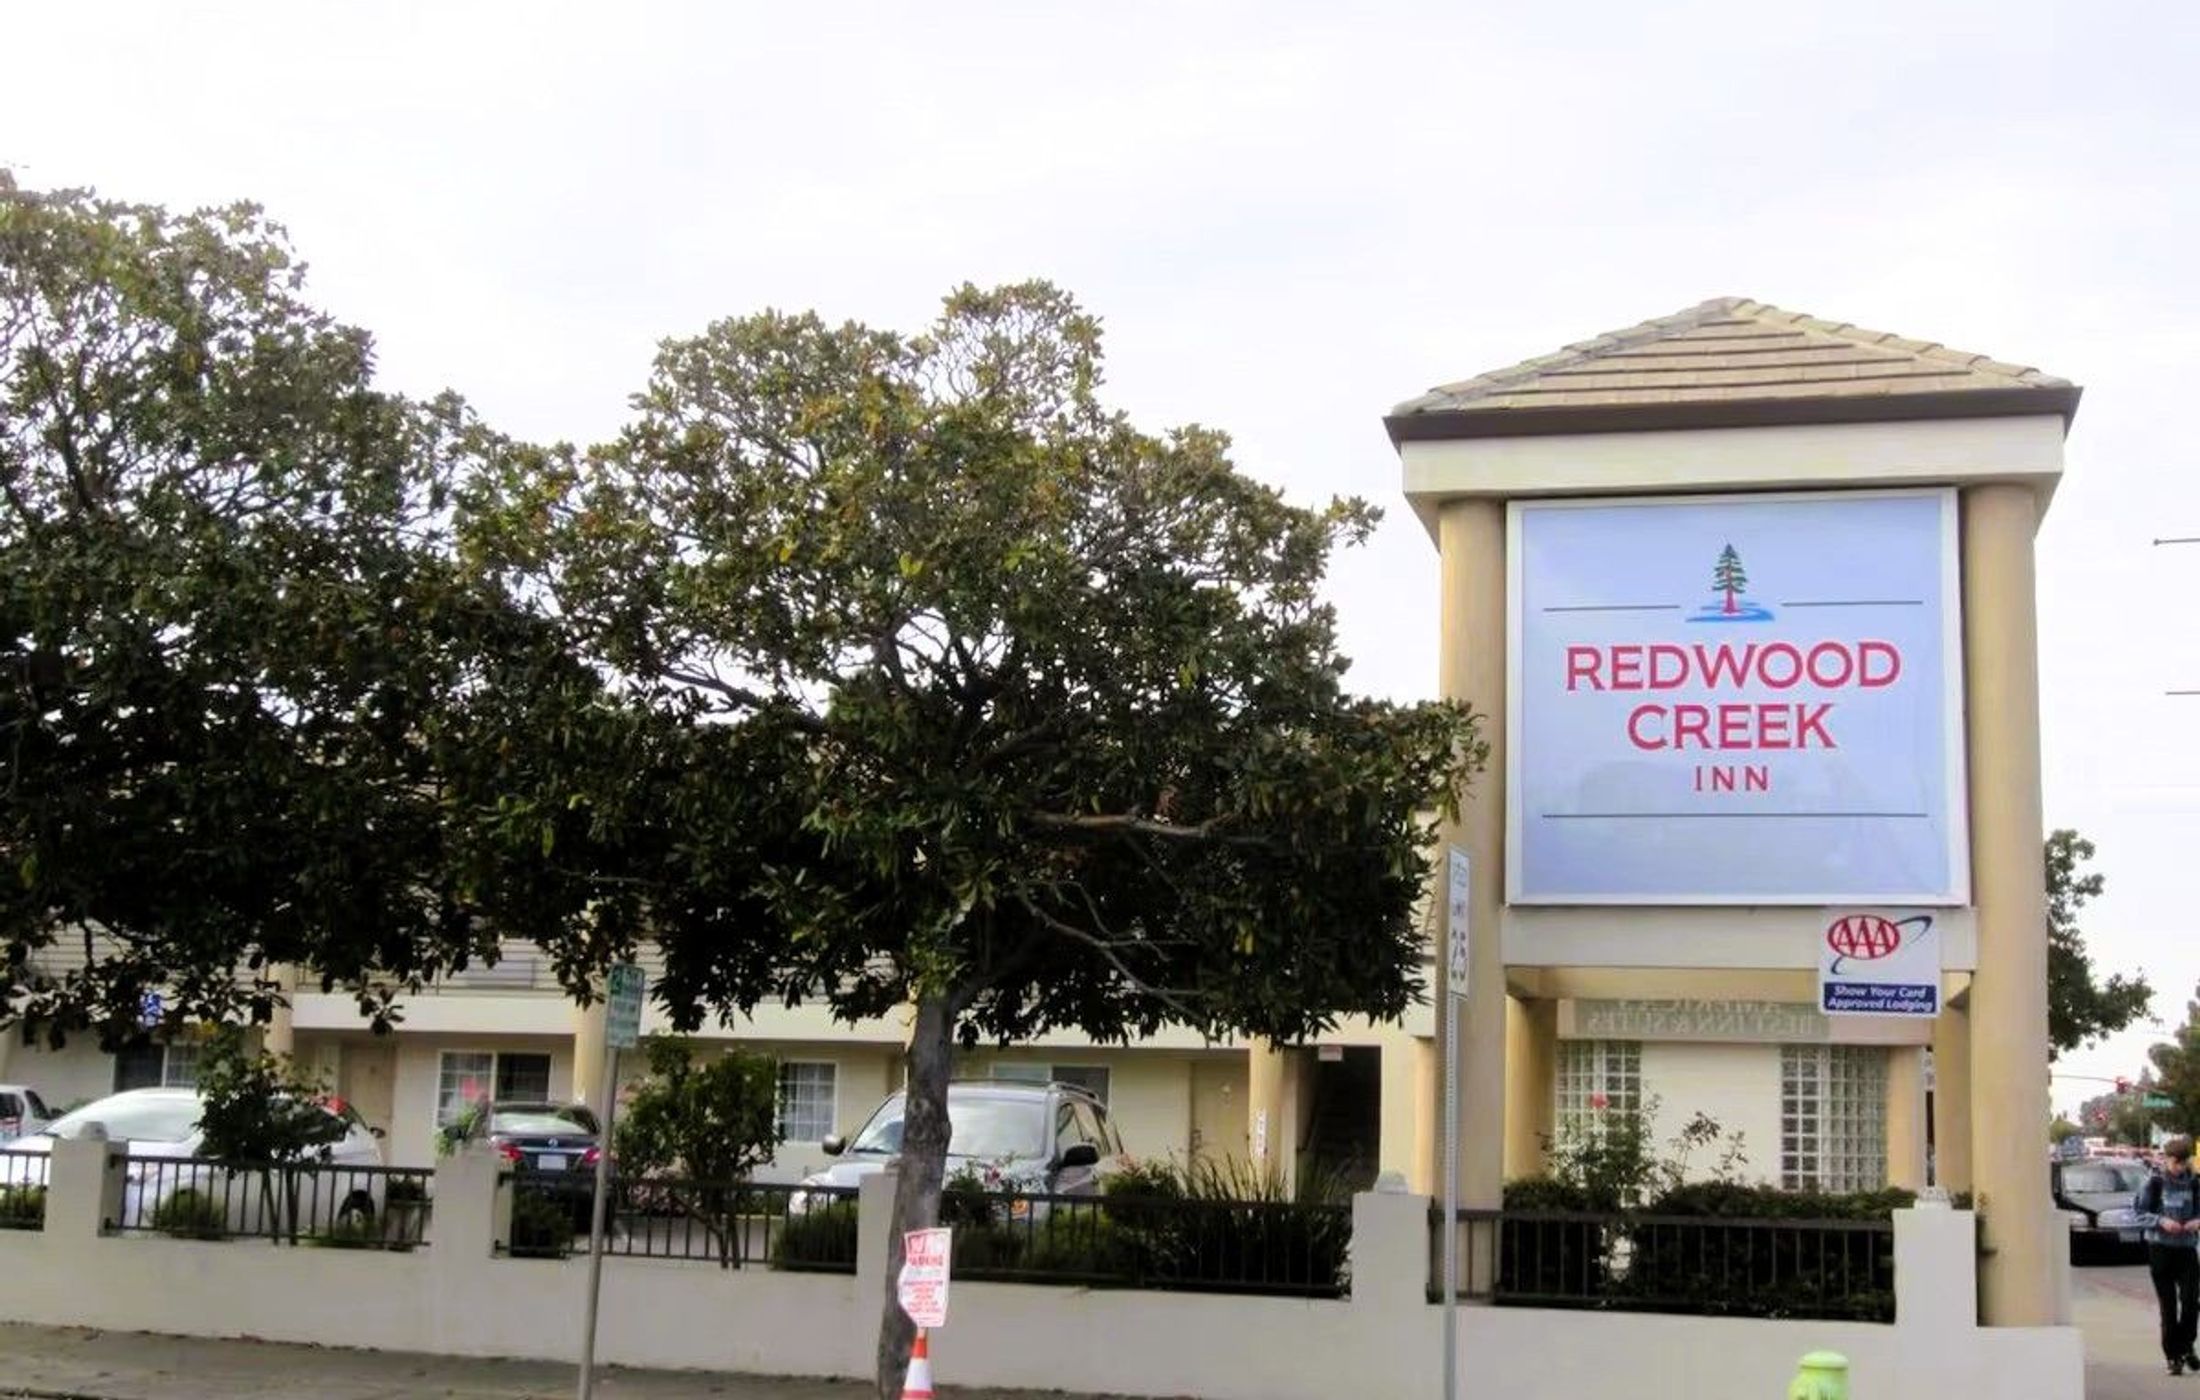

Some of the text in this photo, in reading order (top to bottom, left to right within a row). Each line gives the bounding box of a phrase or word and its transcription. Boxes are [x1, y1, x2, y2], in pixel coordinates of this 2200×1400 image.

[1566, 642, 1901, 691] REDWOOD
[1628, 703, 1836, 751] CREEK
[1695, 765, 1769, 792] INN
[1836, 917, 1893, 958] AAA
[1828, 998, 1934, 1012] Approved Lodging
[1834, 985, 1927, 998] Show Your Card
